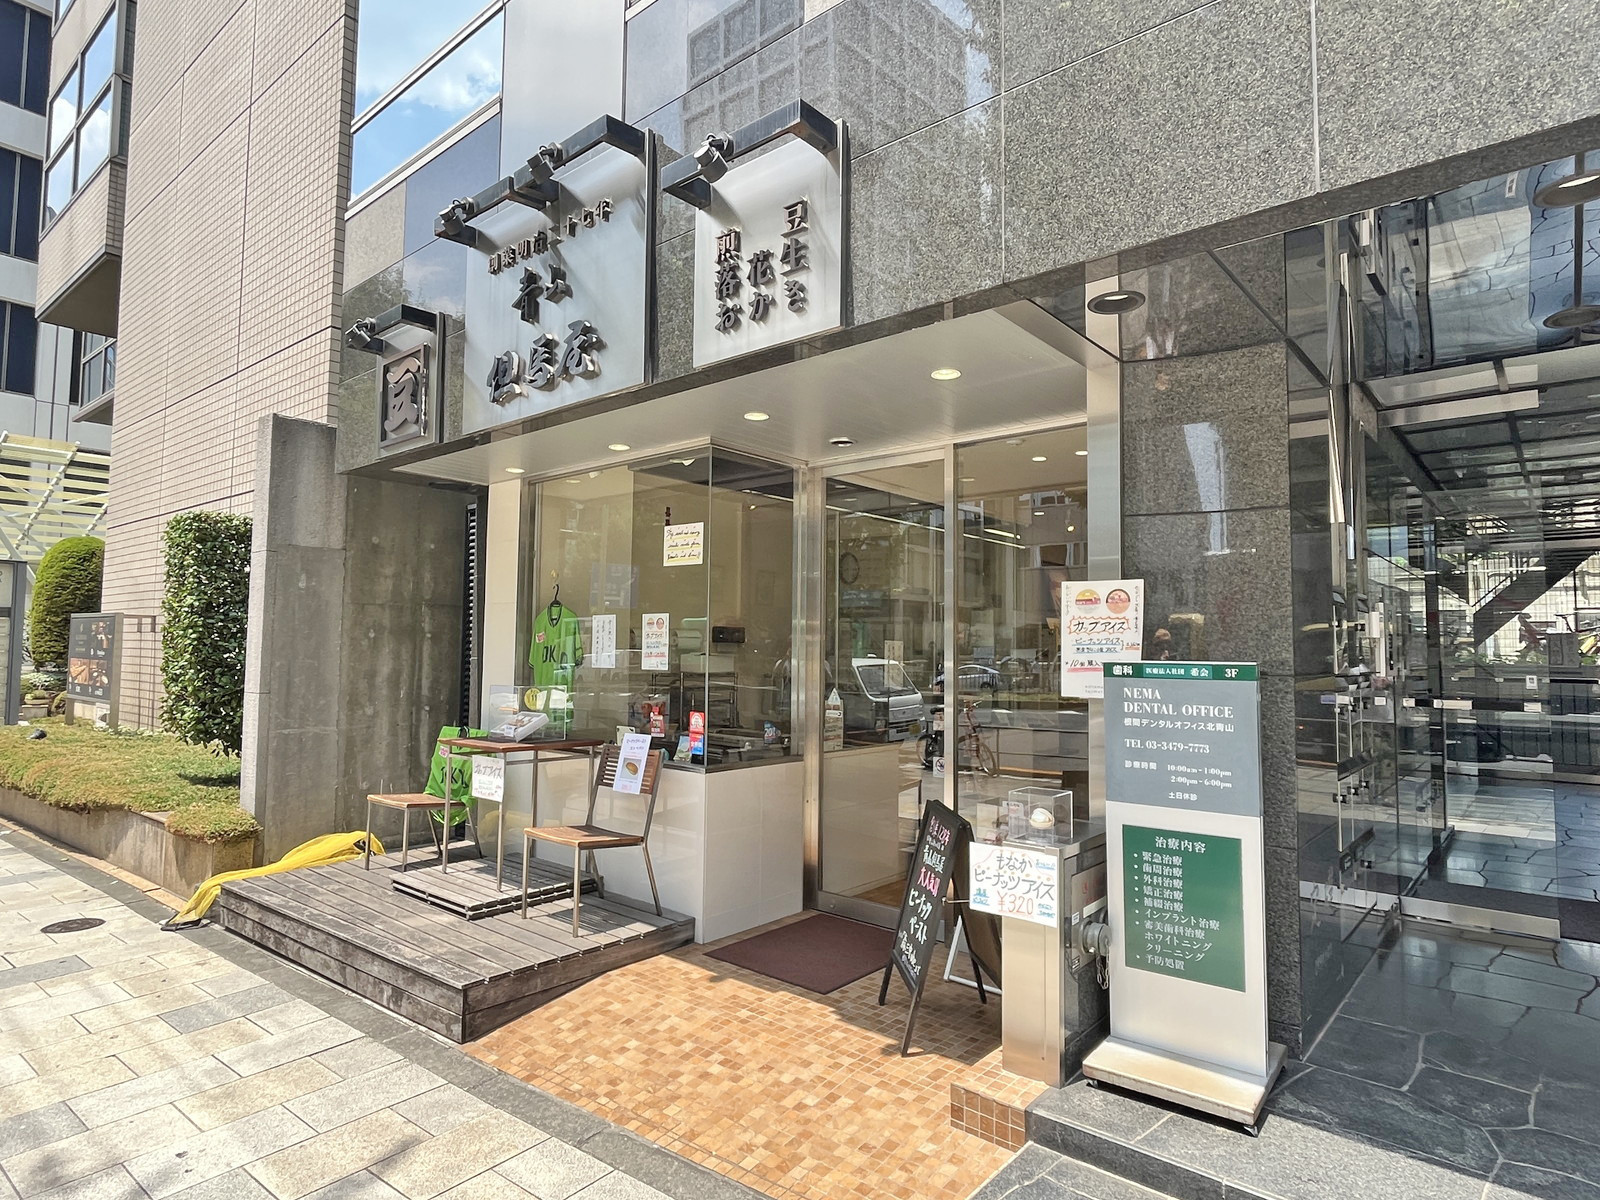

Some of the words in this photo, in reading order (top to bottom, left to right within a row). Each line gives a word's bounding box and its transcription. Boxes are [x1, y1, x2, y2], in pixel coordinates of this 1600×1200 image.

[1112, 664, 1133, 676] 歯科
[1224, 668, 1239, 678] 3F
[1123, 687, 1161, 700] NEMA
[1123, 702, 1178, 715] DENTAL
[1182, 704, 1234, 718] OFFICE
[1124, 738, 1144, 749] TEL
[1145, 740, 1210, 754] 03-3479-7773
[1124, 760, 1157, 770] 診療時間
[1168, 792, 1198, 801] 土日休診
[1155, 836, 1206, 854] 治療内容
[996, 853, 1032, 873] もなか
[1142, 851, 1183, 866] 緊急治療
[974, 868, 1055, 901] ピーナッツアイス
[1143, 874, 1183, 889] 外科治療
[1143, 885, 1183, 901] 矯正治療
[996, 890, 1034, 915] ¥320
[1145, 908, 1220, 931] インプラント治療
[1144, 920, 1206, 940] 審美歯科治療
[1144, 931, 1213, 952] ホワイトニング
[1145, 943, 1206, 961] クリーニング
[1145, 954, 1185, 971] 予防処置
